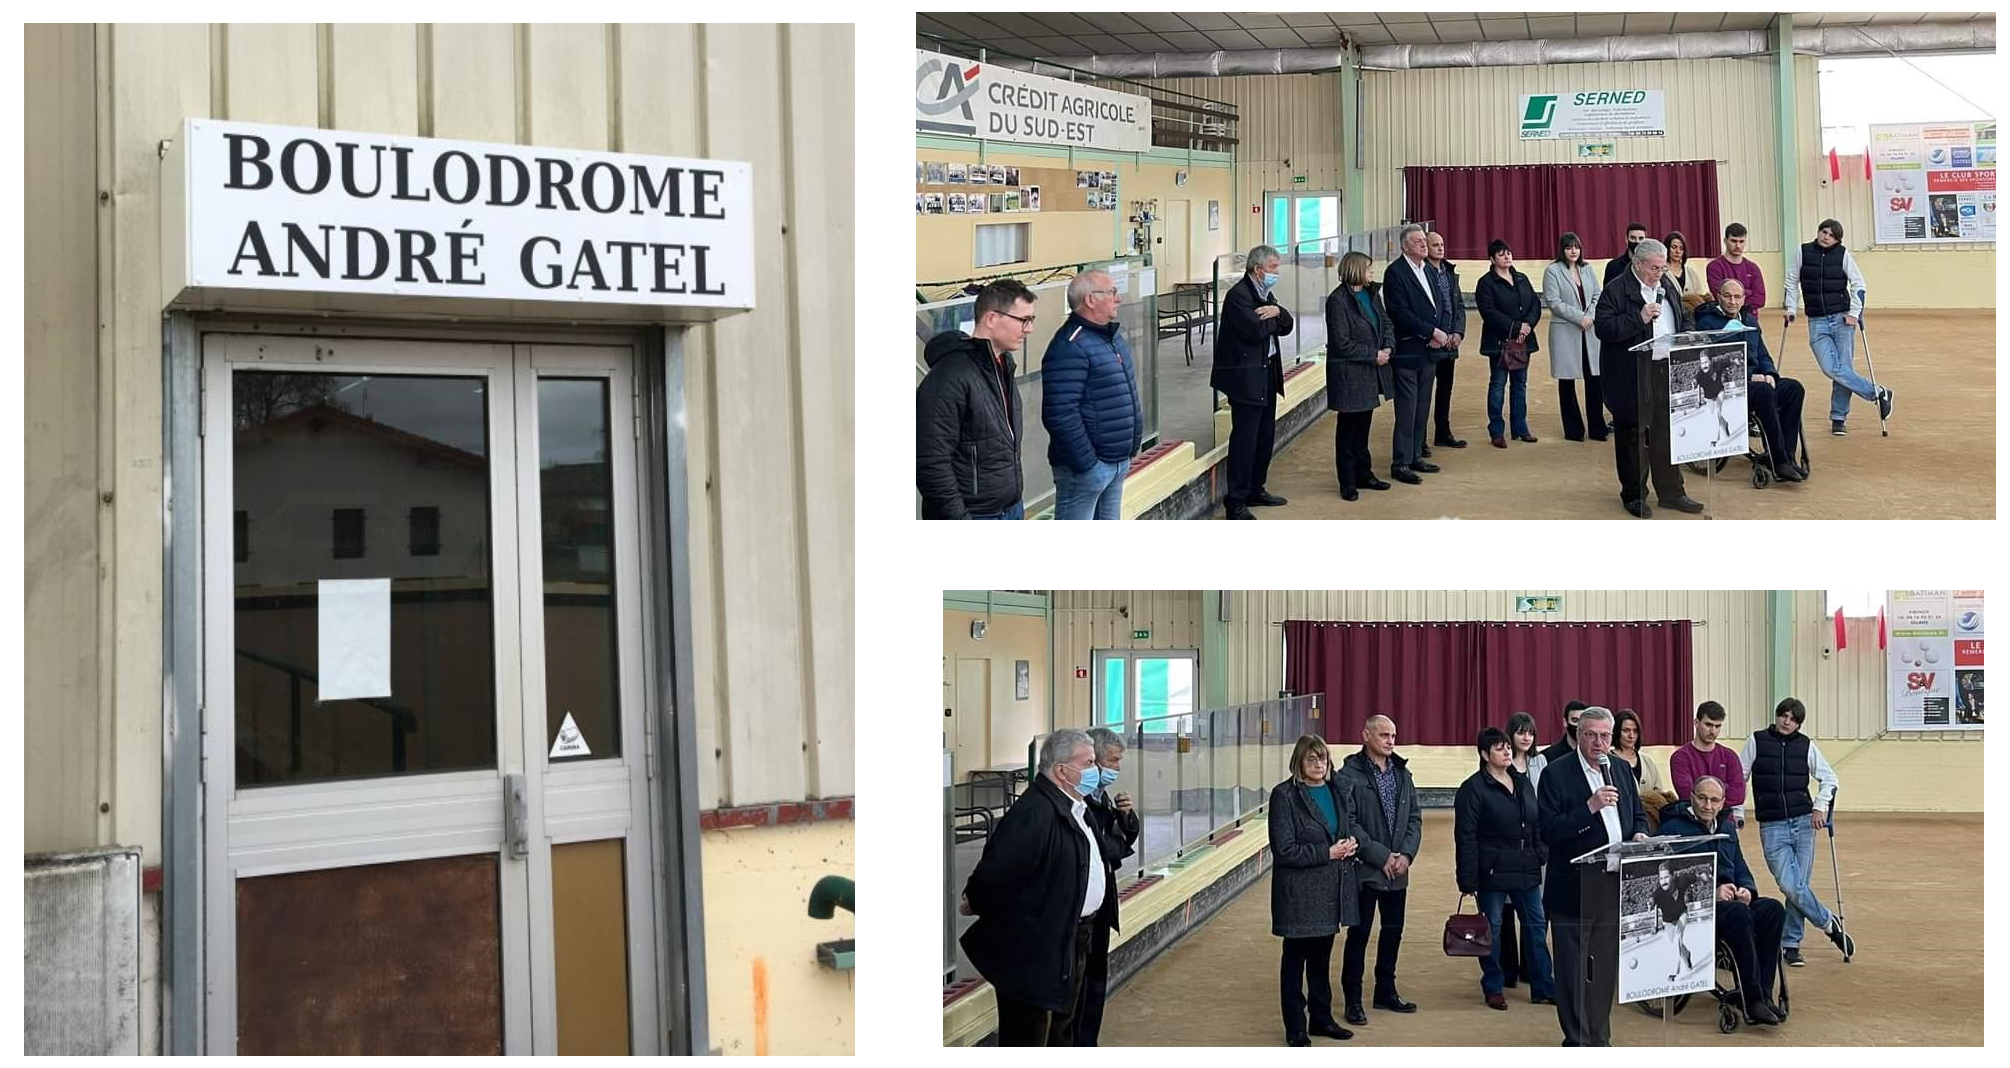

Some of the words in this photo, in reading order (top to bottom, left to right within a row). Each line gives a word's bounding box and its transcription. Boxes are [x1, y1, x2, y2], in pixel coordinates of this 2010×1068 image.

[988, 82, 1058, 112] CRÉDIT
[1061, 95, 1136, 124] AGRICOLE
[1573, 90, 1646, 106] SERNED
[989, 112, 1020, 135] DU
[1023, 115, 1095, 143] SUD-EST
[1520, 130, 1551, 138] SERNED
[222, 132, 726, 220] BOULODROME
[227, 218, 487, 286] ANDRÉ
[519, 235, 726, 296] GATEL
[1970, 641, 1981, 649] LE
[1626, 985, 1670, 1000] BOULODROME
[1690, 980, 1709, 990] GATEL
